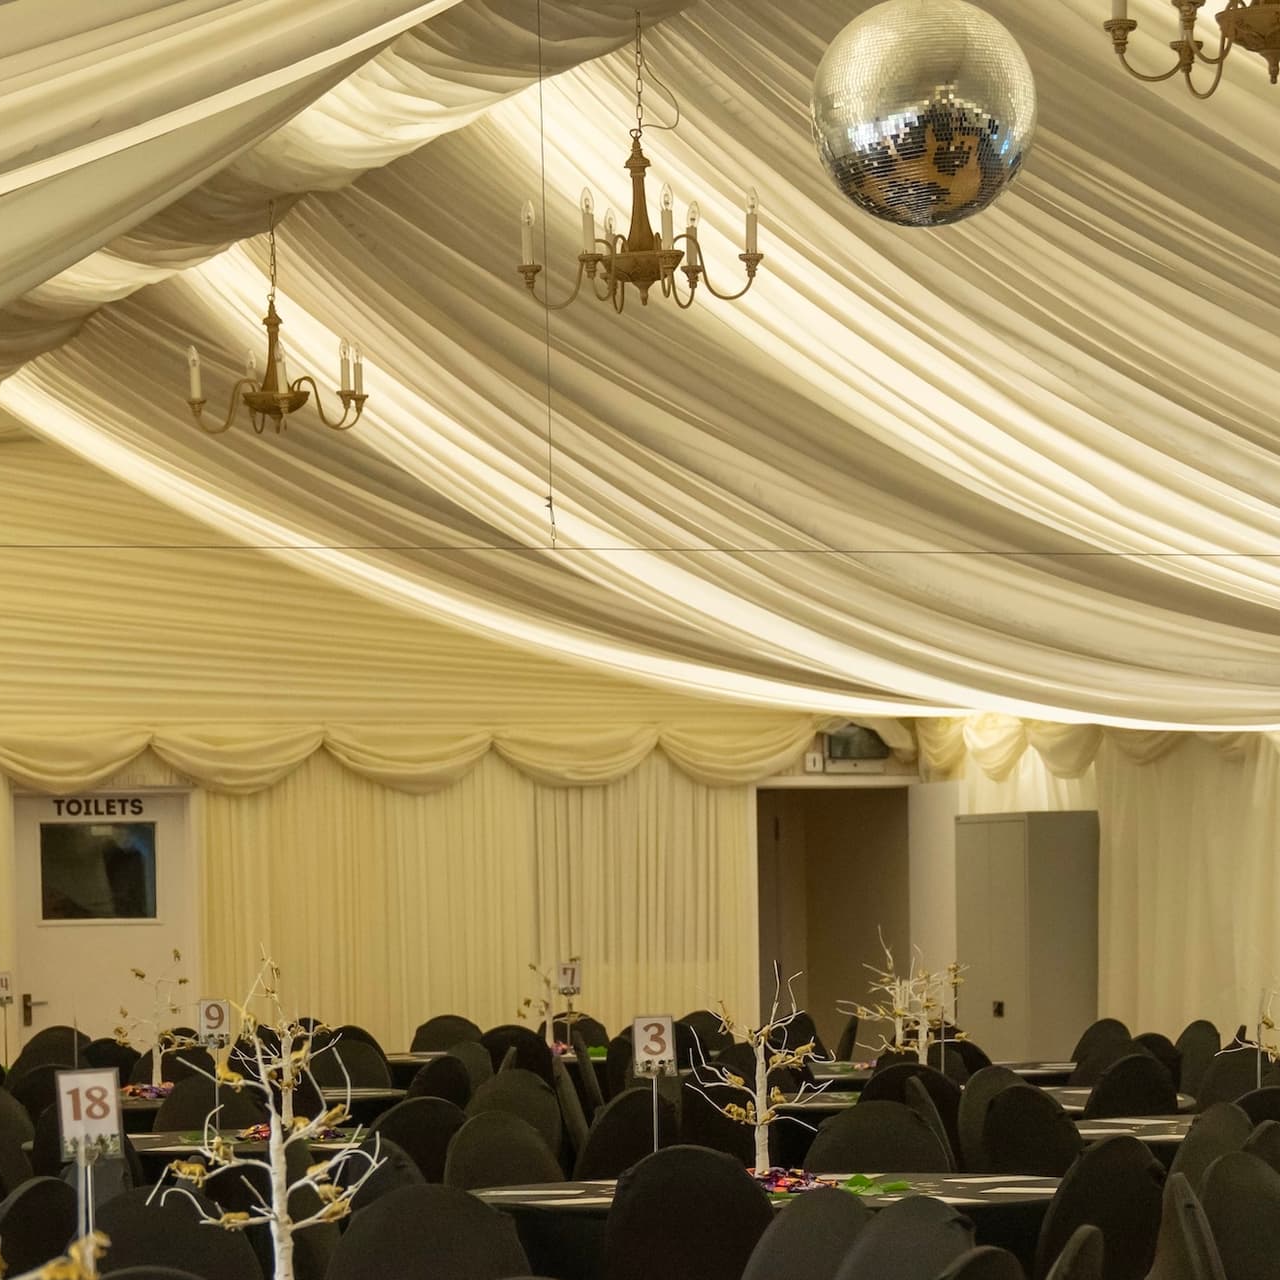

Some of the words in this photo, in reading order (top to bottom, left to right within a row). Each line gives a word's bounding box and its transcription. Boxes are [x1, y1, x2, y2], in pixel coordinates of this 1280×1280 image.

[52, 798, 144, 817] TOILETS
[562, 966, 576, 986] 7
[204, 1002, 225, 1031] 9
[642, 1022, 667, 1056] 3
[65, 1085, 111, 1121] 18
